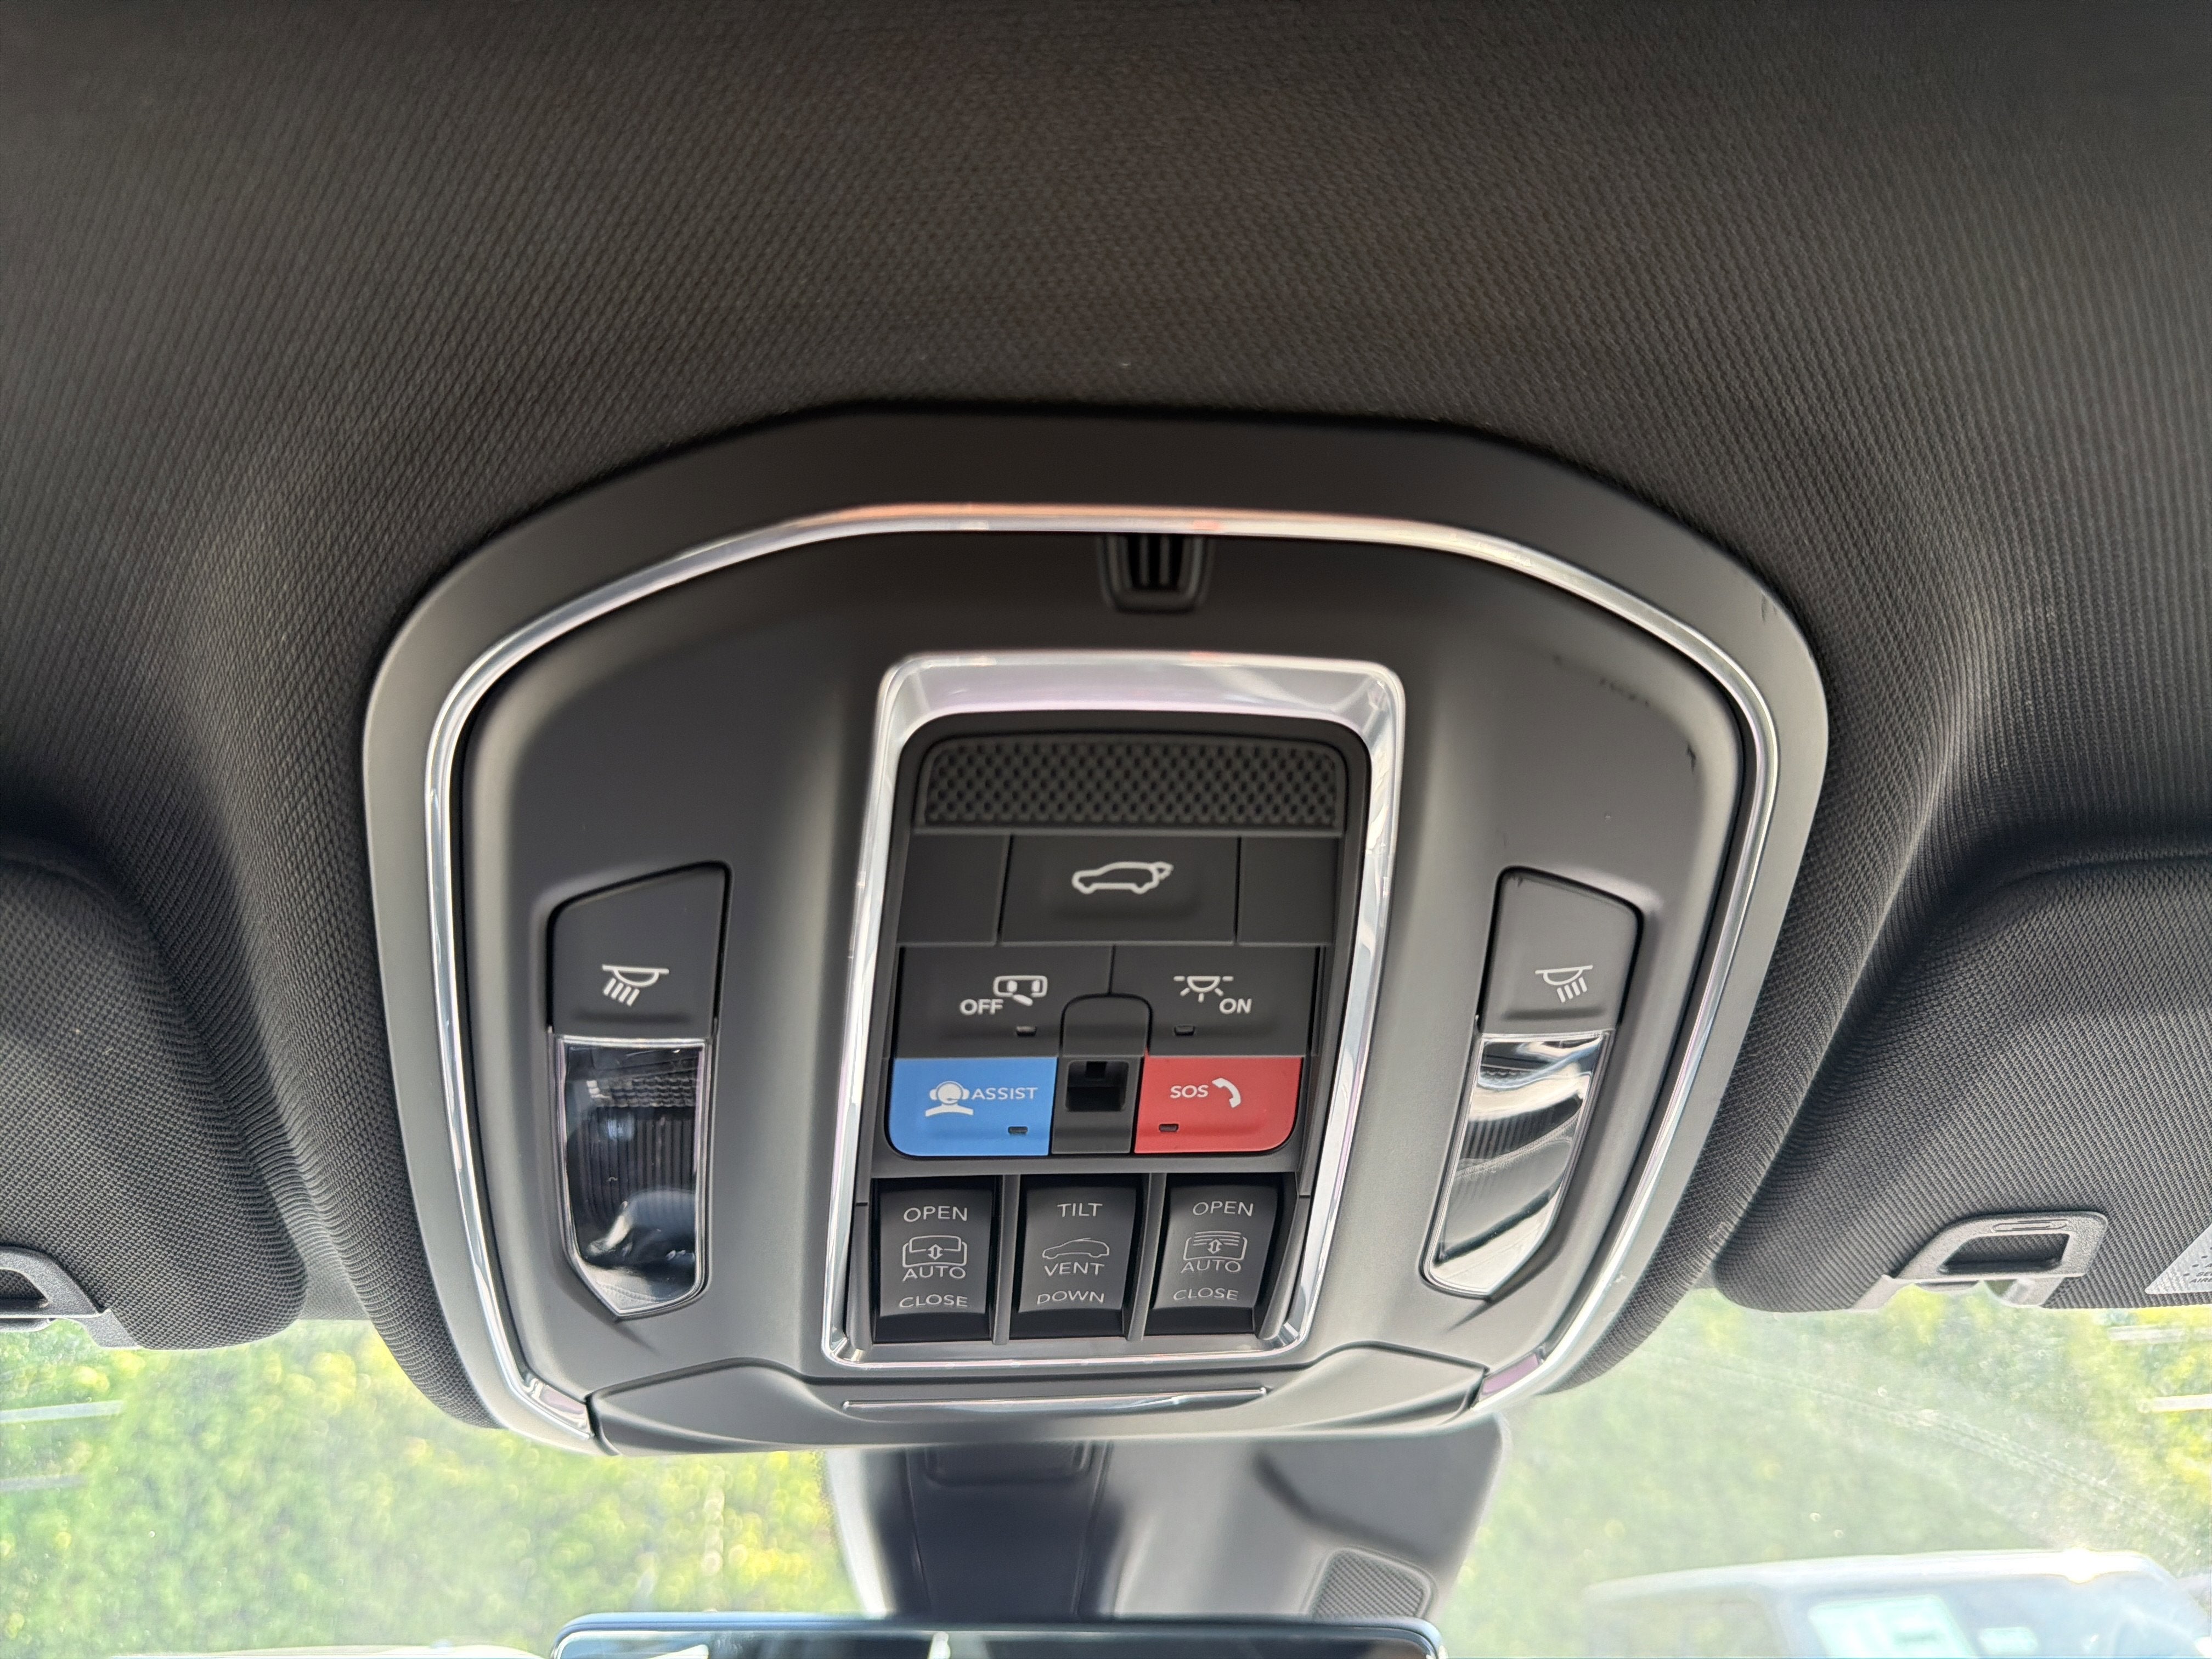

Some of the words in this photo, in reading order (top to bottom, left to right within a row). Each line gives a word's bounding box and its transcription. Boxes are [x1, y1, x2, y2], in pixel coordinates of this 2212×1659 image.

[960, 998, 1004, 1015] OFF
[1219, 998, 1252, 1014] ON
[971, 1087, 1038, 1101] ASSIST
[1170, 1085, 1209, 1098] SOS
[903, 1205, 967, 1222] OPEN
[1057, 1203, 1103, 1218] TILT
[1192, 1200, 1254, 1217] OPEN
[902, 1265, 966, 1282] AUTO
[1044, 1262, 1105, 1277] VENT
[1181, 1259, 1242, 1273] AUTO
[899, 1294, 968, 1309] CLOSE
[1036, 1290, 1105, 1305] DOWN
[1173, 1287, 1239, 1301] CLOSE
